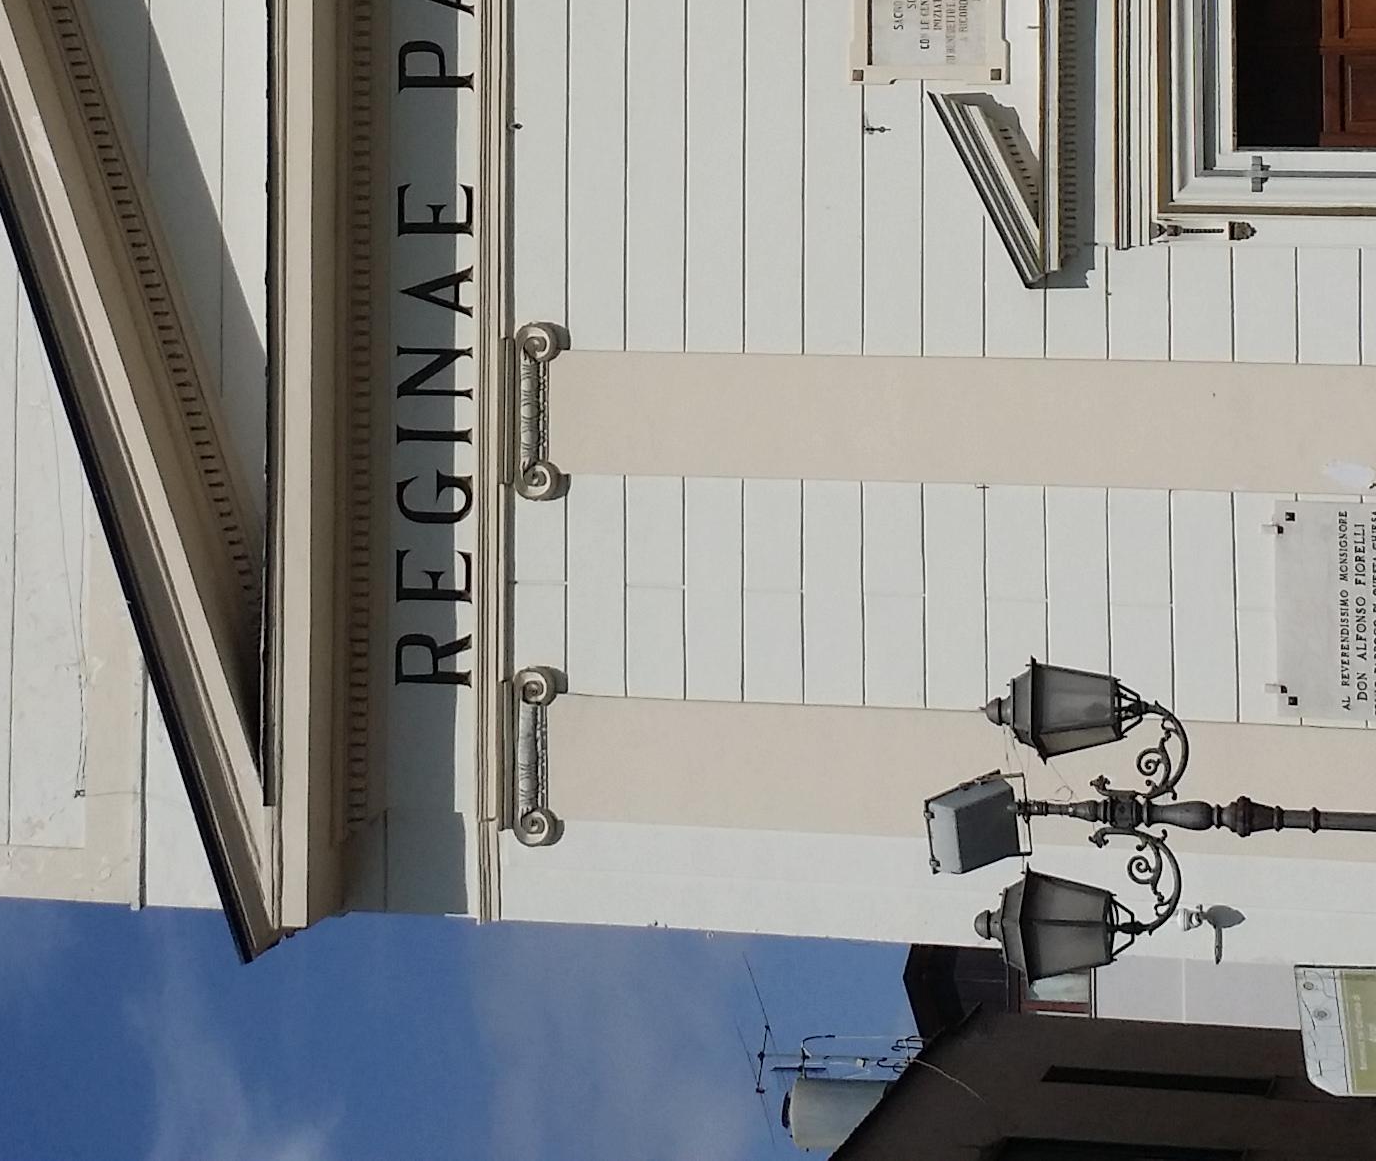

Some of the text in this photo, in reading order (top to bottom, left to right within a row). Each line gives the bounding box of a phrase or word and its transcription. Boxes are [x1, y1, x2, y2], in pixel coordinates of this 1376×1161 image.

[394, 183, 475, 688] REGINAE
[1338, 511, 1351, 711] AL REVERENDISSIMO MONSIGNORE
[1354, 523, 1368, 701] DON ALFONSO FIORELLI
